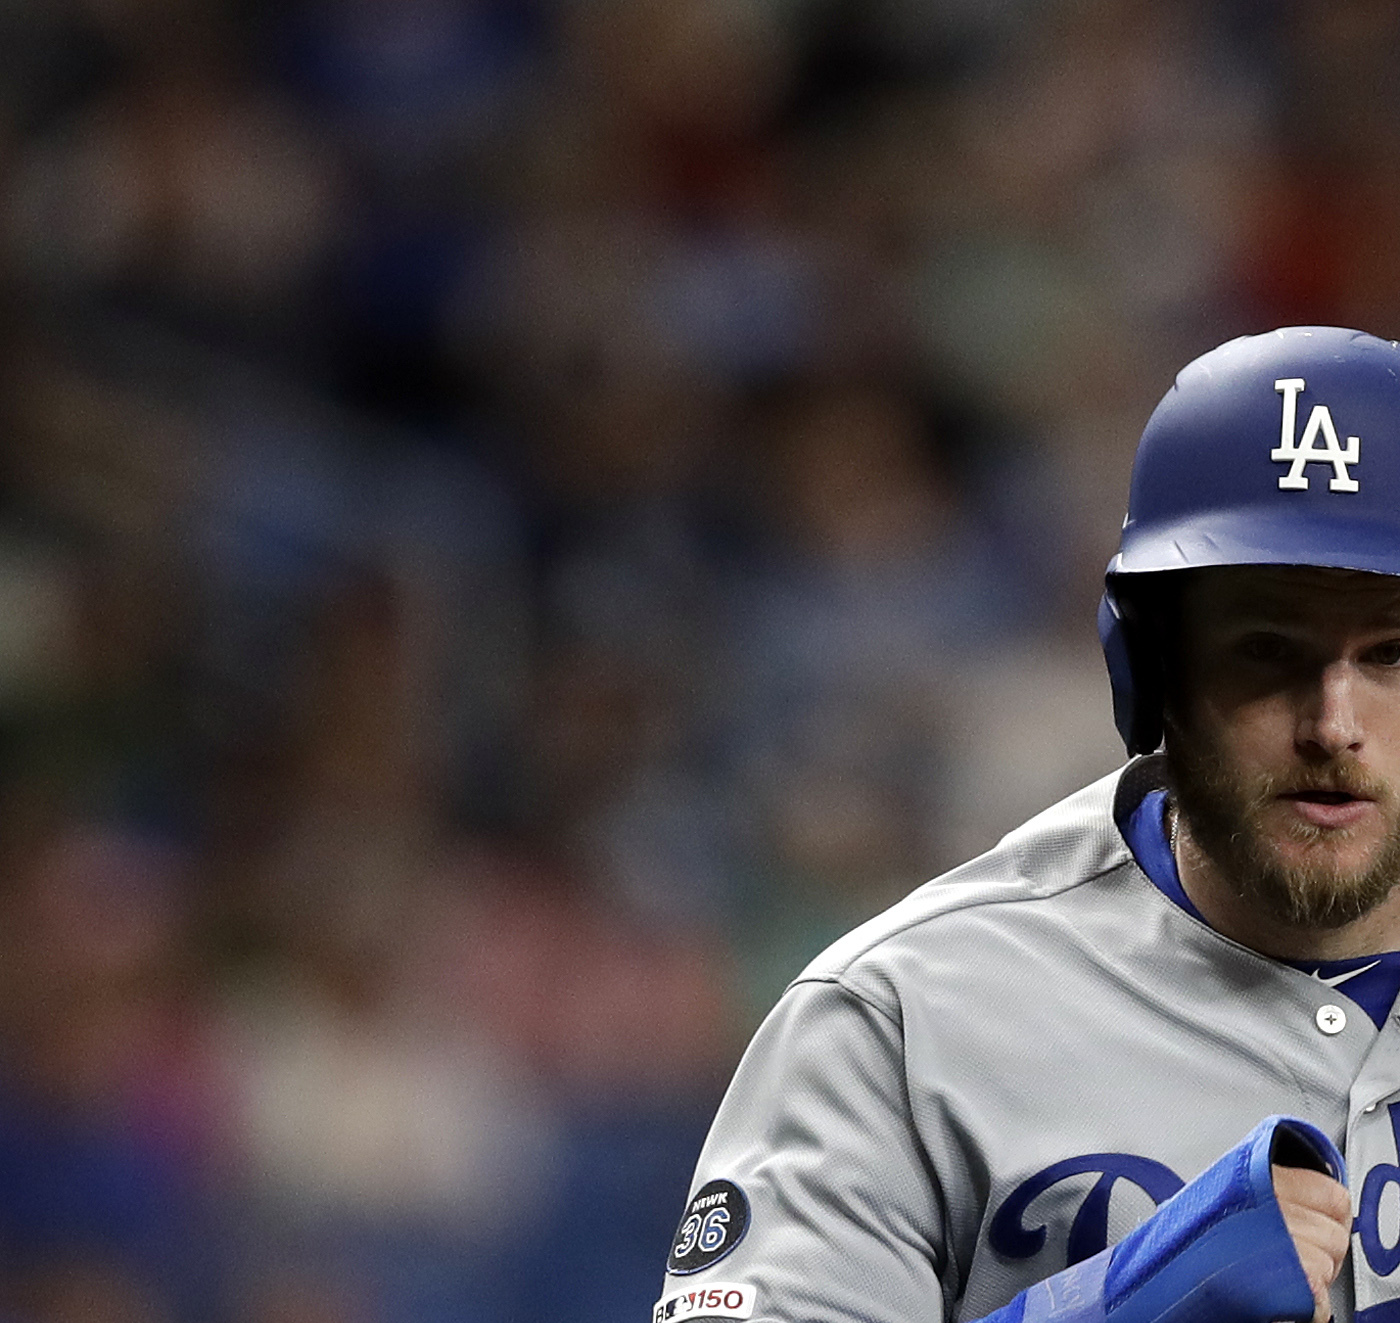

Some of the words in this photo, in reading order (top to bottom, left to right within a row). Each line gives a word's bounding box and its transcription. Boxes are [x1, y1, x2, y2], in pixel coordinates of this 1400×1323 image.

[1271, 378, 1360, 493] LA
[674, 1206, 730, 1258] 36
[697, 1289, 744, 1310] 150
